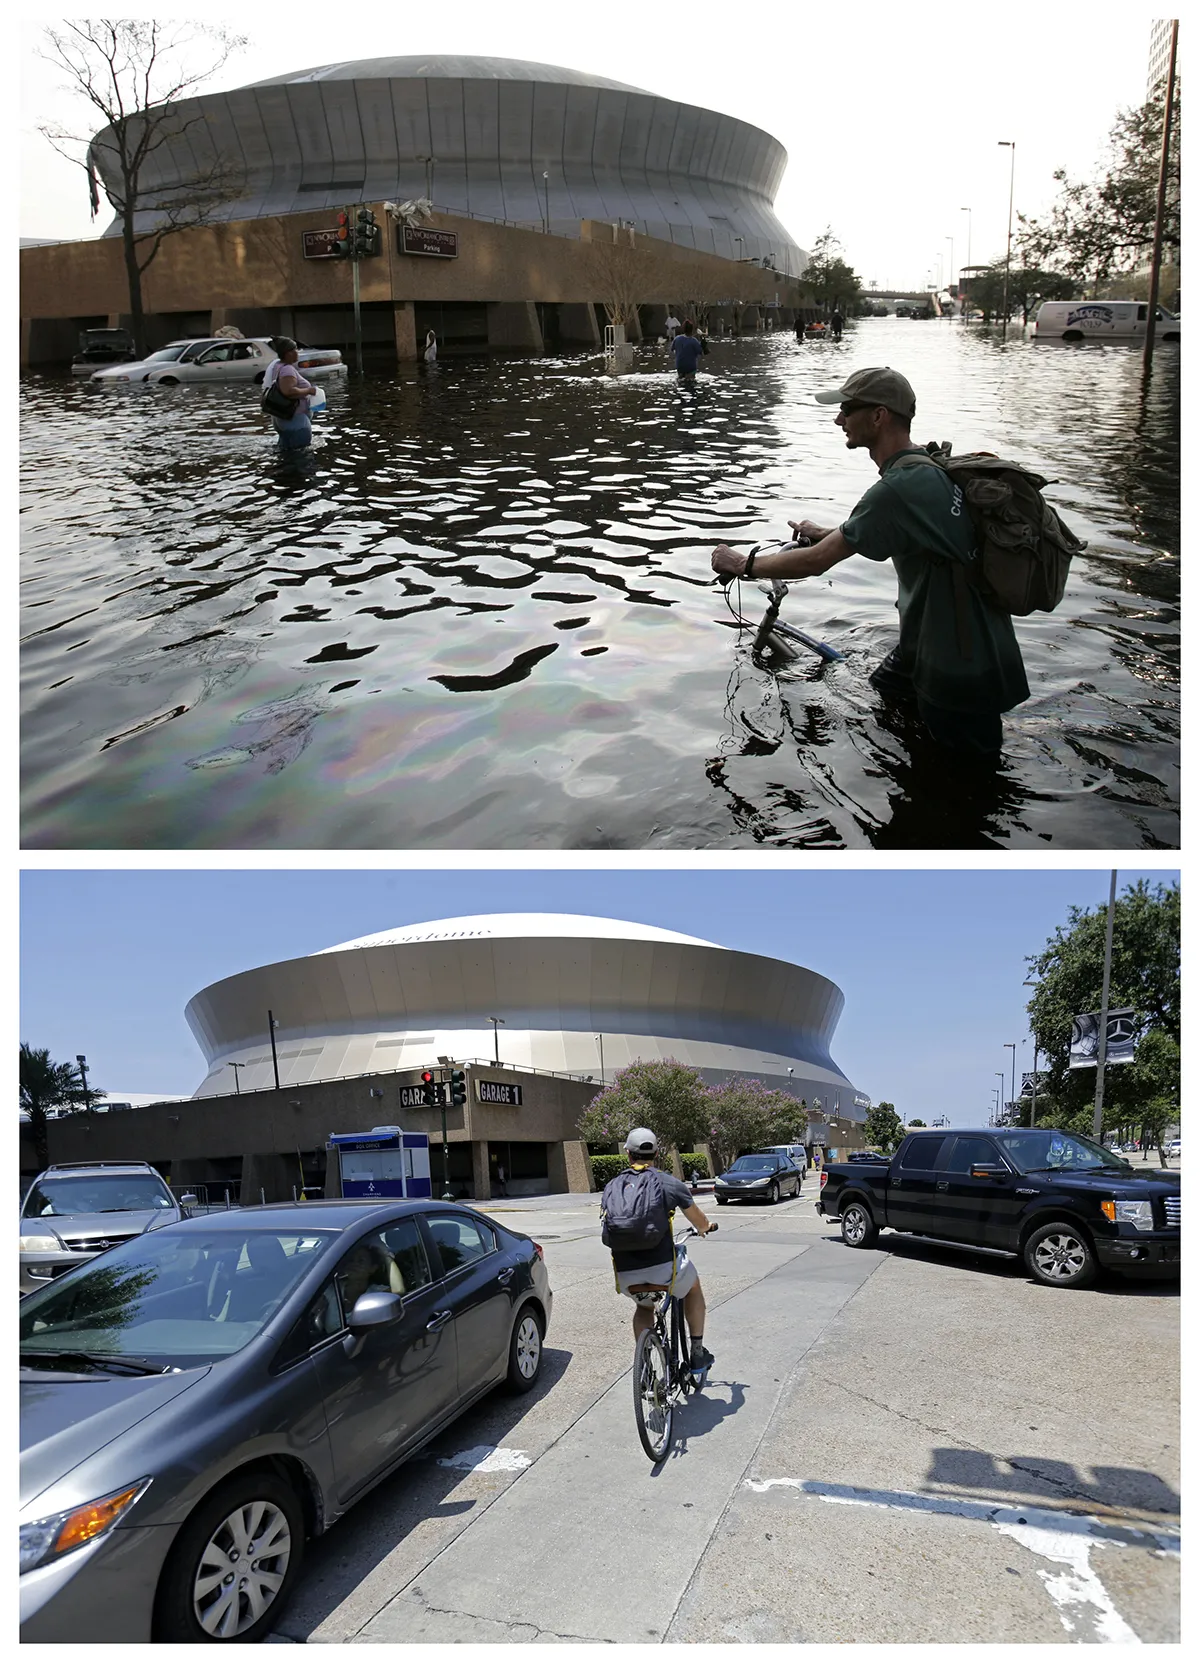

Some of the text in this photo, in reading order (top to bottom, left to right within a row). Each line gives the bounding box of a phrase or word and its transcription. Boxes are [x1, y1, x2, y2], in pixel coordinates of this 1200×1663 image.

[423, 243, 441, 253] Parking
[442, 1082, 451, 1103] 1
[480, 1083, 519, 1105] GARAGE 1
